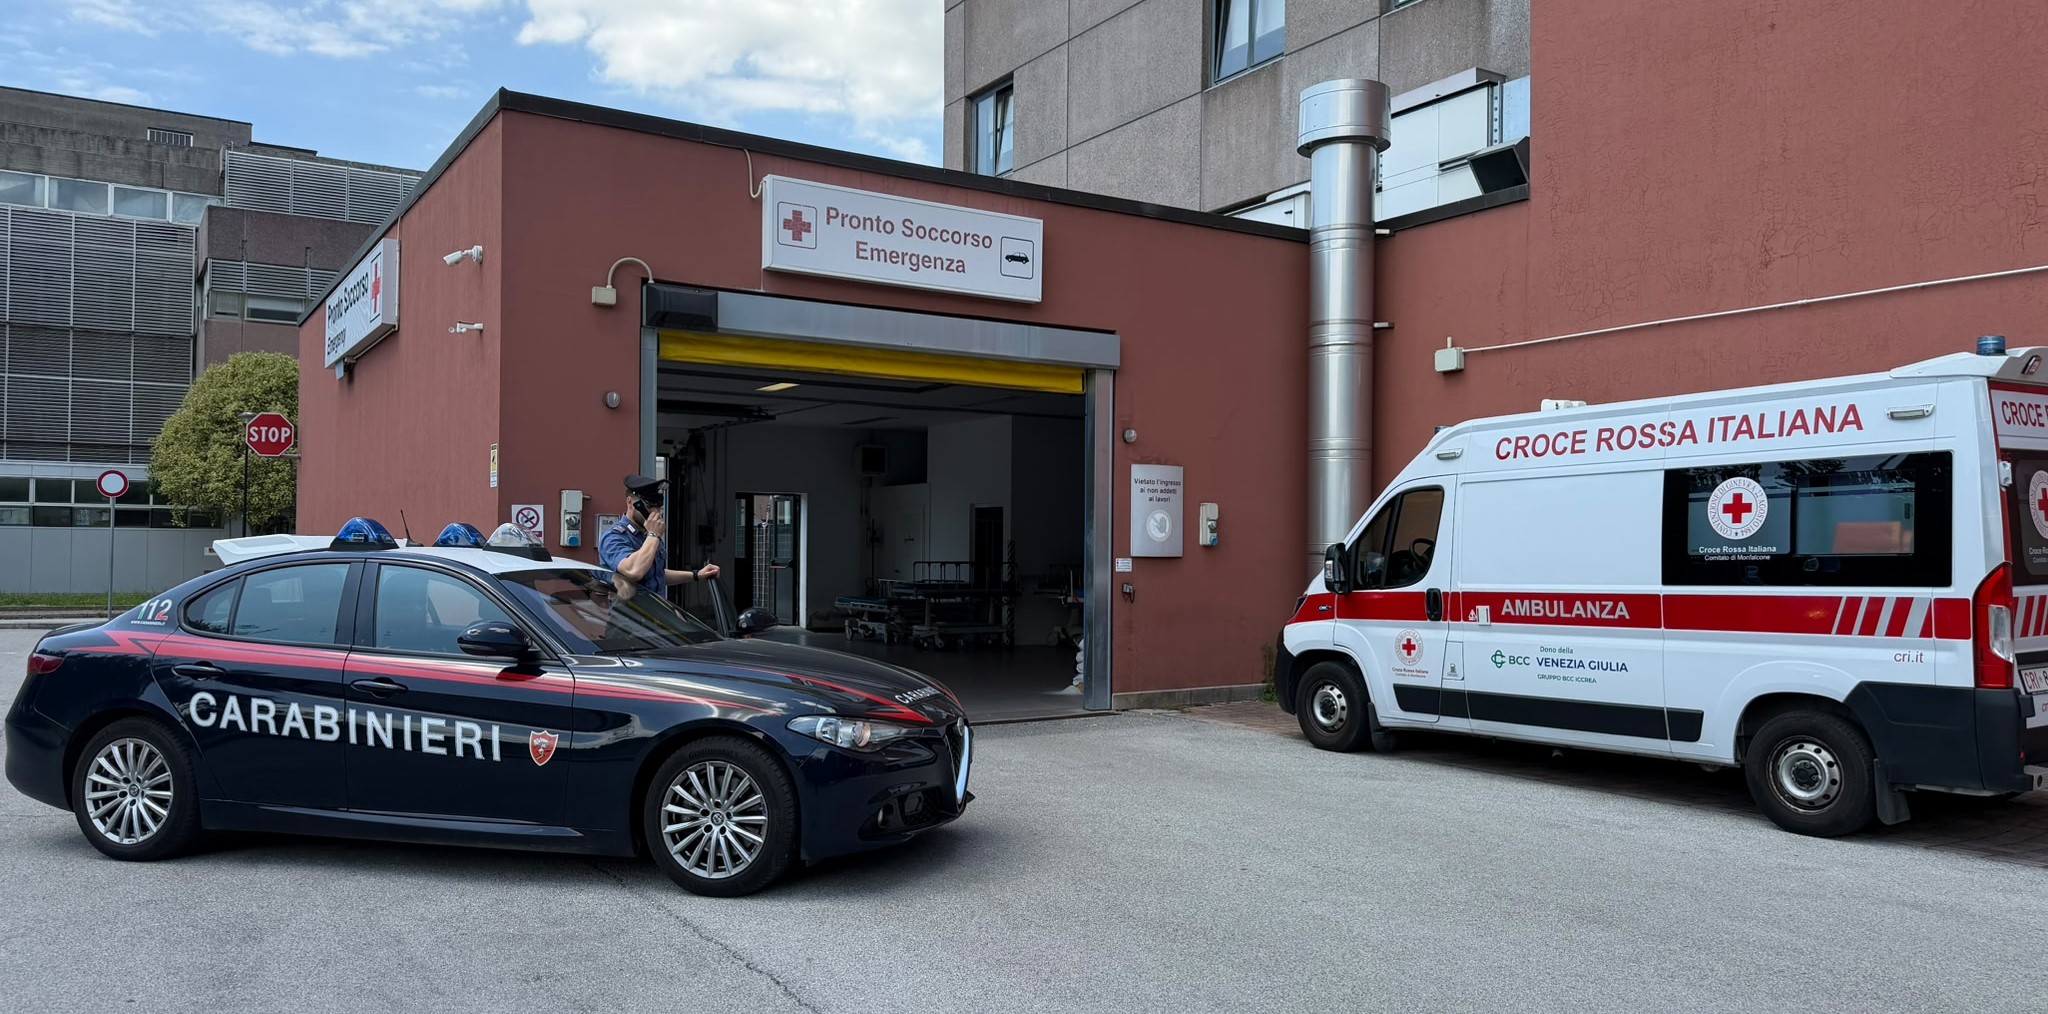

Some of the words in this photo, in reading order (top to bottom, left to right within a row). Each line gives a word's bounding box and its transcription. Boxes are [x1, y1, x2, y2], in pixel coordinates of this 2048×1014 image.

[825, 205, 895, 235] Pronto
[901, 217, 993, 250] Soccorso
[855, 239, 966, 274] Emergenza
[327, 296, 343, 324] Pronto
[344, 272, 369, 314] Soccorso
[2001, 400, 2046, 428] CROCE
[249, 426, 291, 443] STOP
[1494, 429, 1588, 460] CROCE
[1595, 419, 1698, 452] ROSSA
[1707, 403, 1864, 443] ITALIANA
[1156, 478, 1182, 487] l'ingresso
[1726, 479, 1756, 493] GINEVRA
[1755, 499, 1767, 528] AGOSTO
[1699, 546, 1721, 554] Croce
[1722, 545, 1747, 553] Rossa
[1748, 545, 1777, 553] Italiana
[137, 599, 173, 621] 112
[1501, 599, 1631, 620] AMBULANZA
[1539, 646, 1556, 654] Dono
[1557, 646, 1574, 655] della
[1893, 651, 1925, 663] cri.it
[1508, 655, 1531, 666] BCC
[1536, 657, 1586, 670] VENEZIA
[1588, 660, 1629, 672] GIULIA
[1537, 673, 1562, 681] GRUPPO
[1575, 676, 1597, 684] ICCREA
[2024, 671, 2041, 689] CRI
[188, 691, 503, 762] CARABINIERI
